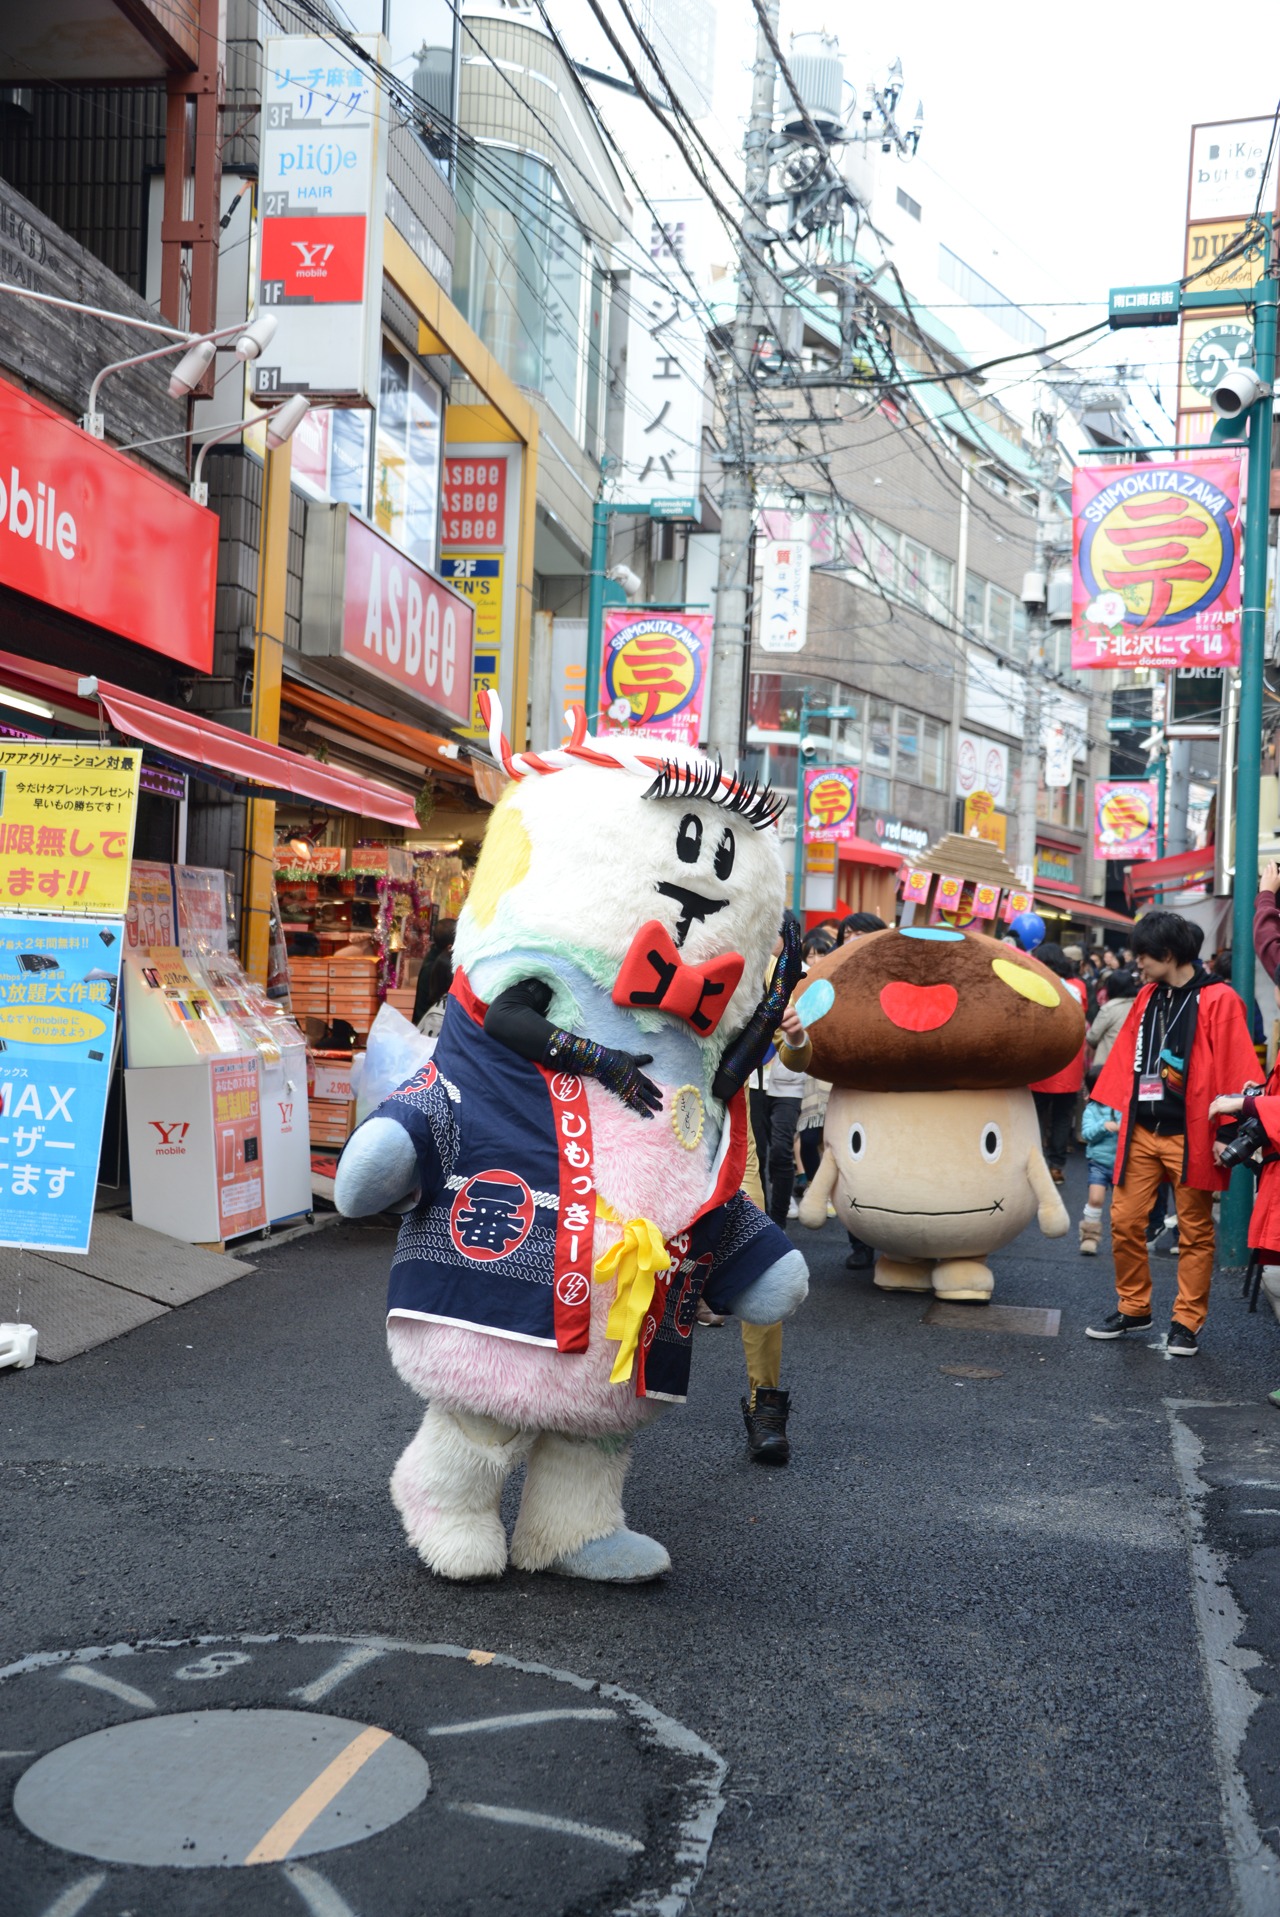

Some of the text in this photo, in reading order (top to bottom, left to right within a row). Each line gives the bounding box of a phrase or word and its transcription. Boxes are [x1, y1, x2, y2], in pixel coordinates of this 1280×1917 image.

[299, 90, 369, 119] リング
[269, 106, 291, 128] 3F
[278, 143, 358, 176] pli(j)e
[297, 186, 333, 199] HAIR
[265, 195, 286, 216] 2F
[291, 241, 335, 268] Y!
[296, 268, 328, 278] mobile
[264, 283, 283, 304] 1F
[1113, 290, 1175, 308] 南口商店街
[258, 370, 279, 391] B1
[653, 500, 692, 509] shimokita
[1085, 472, 1227, 523] SHIMOKITAZAWA
[453, 560, 477, 578] 2F
[446, 580, 491, 595] EN'S
[611, 619, 700, 651] SHIMOKITAZAWA
[1138, 657, 1178, 666] docomo
[885, 821, 928, 848] red mango
[0, 867, 91, 898] ます!!
[0, 1067, 29, 1078] ックス
[278, 1102, 294, 1125] Y!
[147, 1121, 190, 1146] Y!
[155, 1145, 186, 1156] mobile
[561, 1110, 593, 1263] しもっきー
